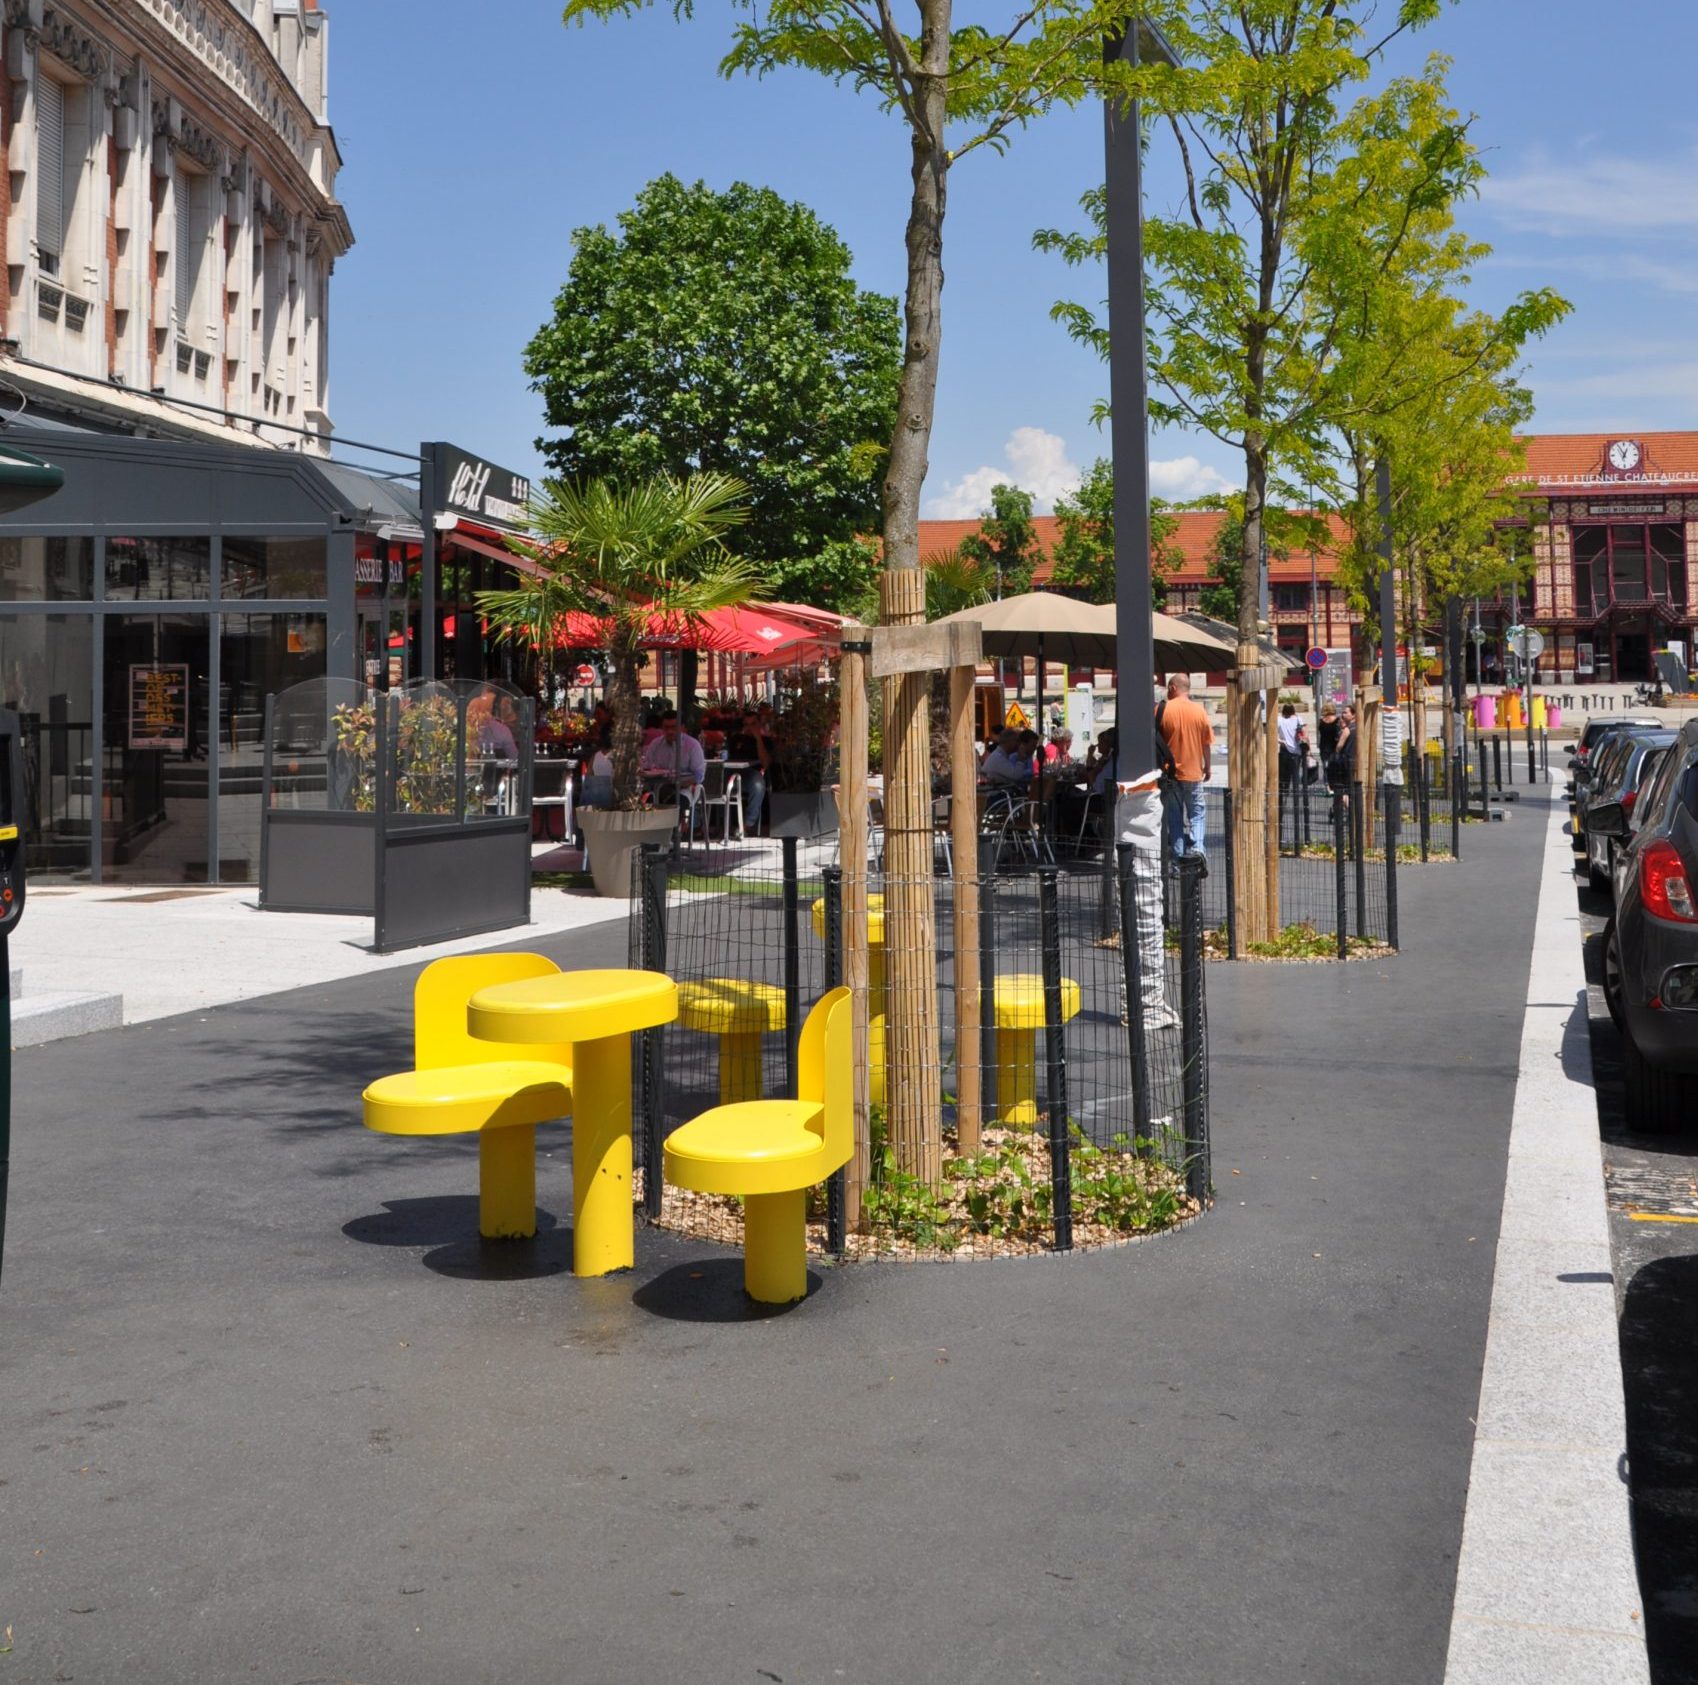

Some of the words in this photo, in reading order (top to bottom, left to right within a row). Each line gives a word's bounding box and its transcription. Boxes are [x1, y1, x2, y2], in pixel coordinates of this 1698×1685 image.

[1539, 475, 1552, 483] DE
[1557, 475, 1568, 483] ST
[1573, 474, 1620, 483] ETIENNE
[388, 560, 403, 583] BAR
